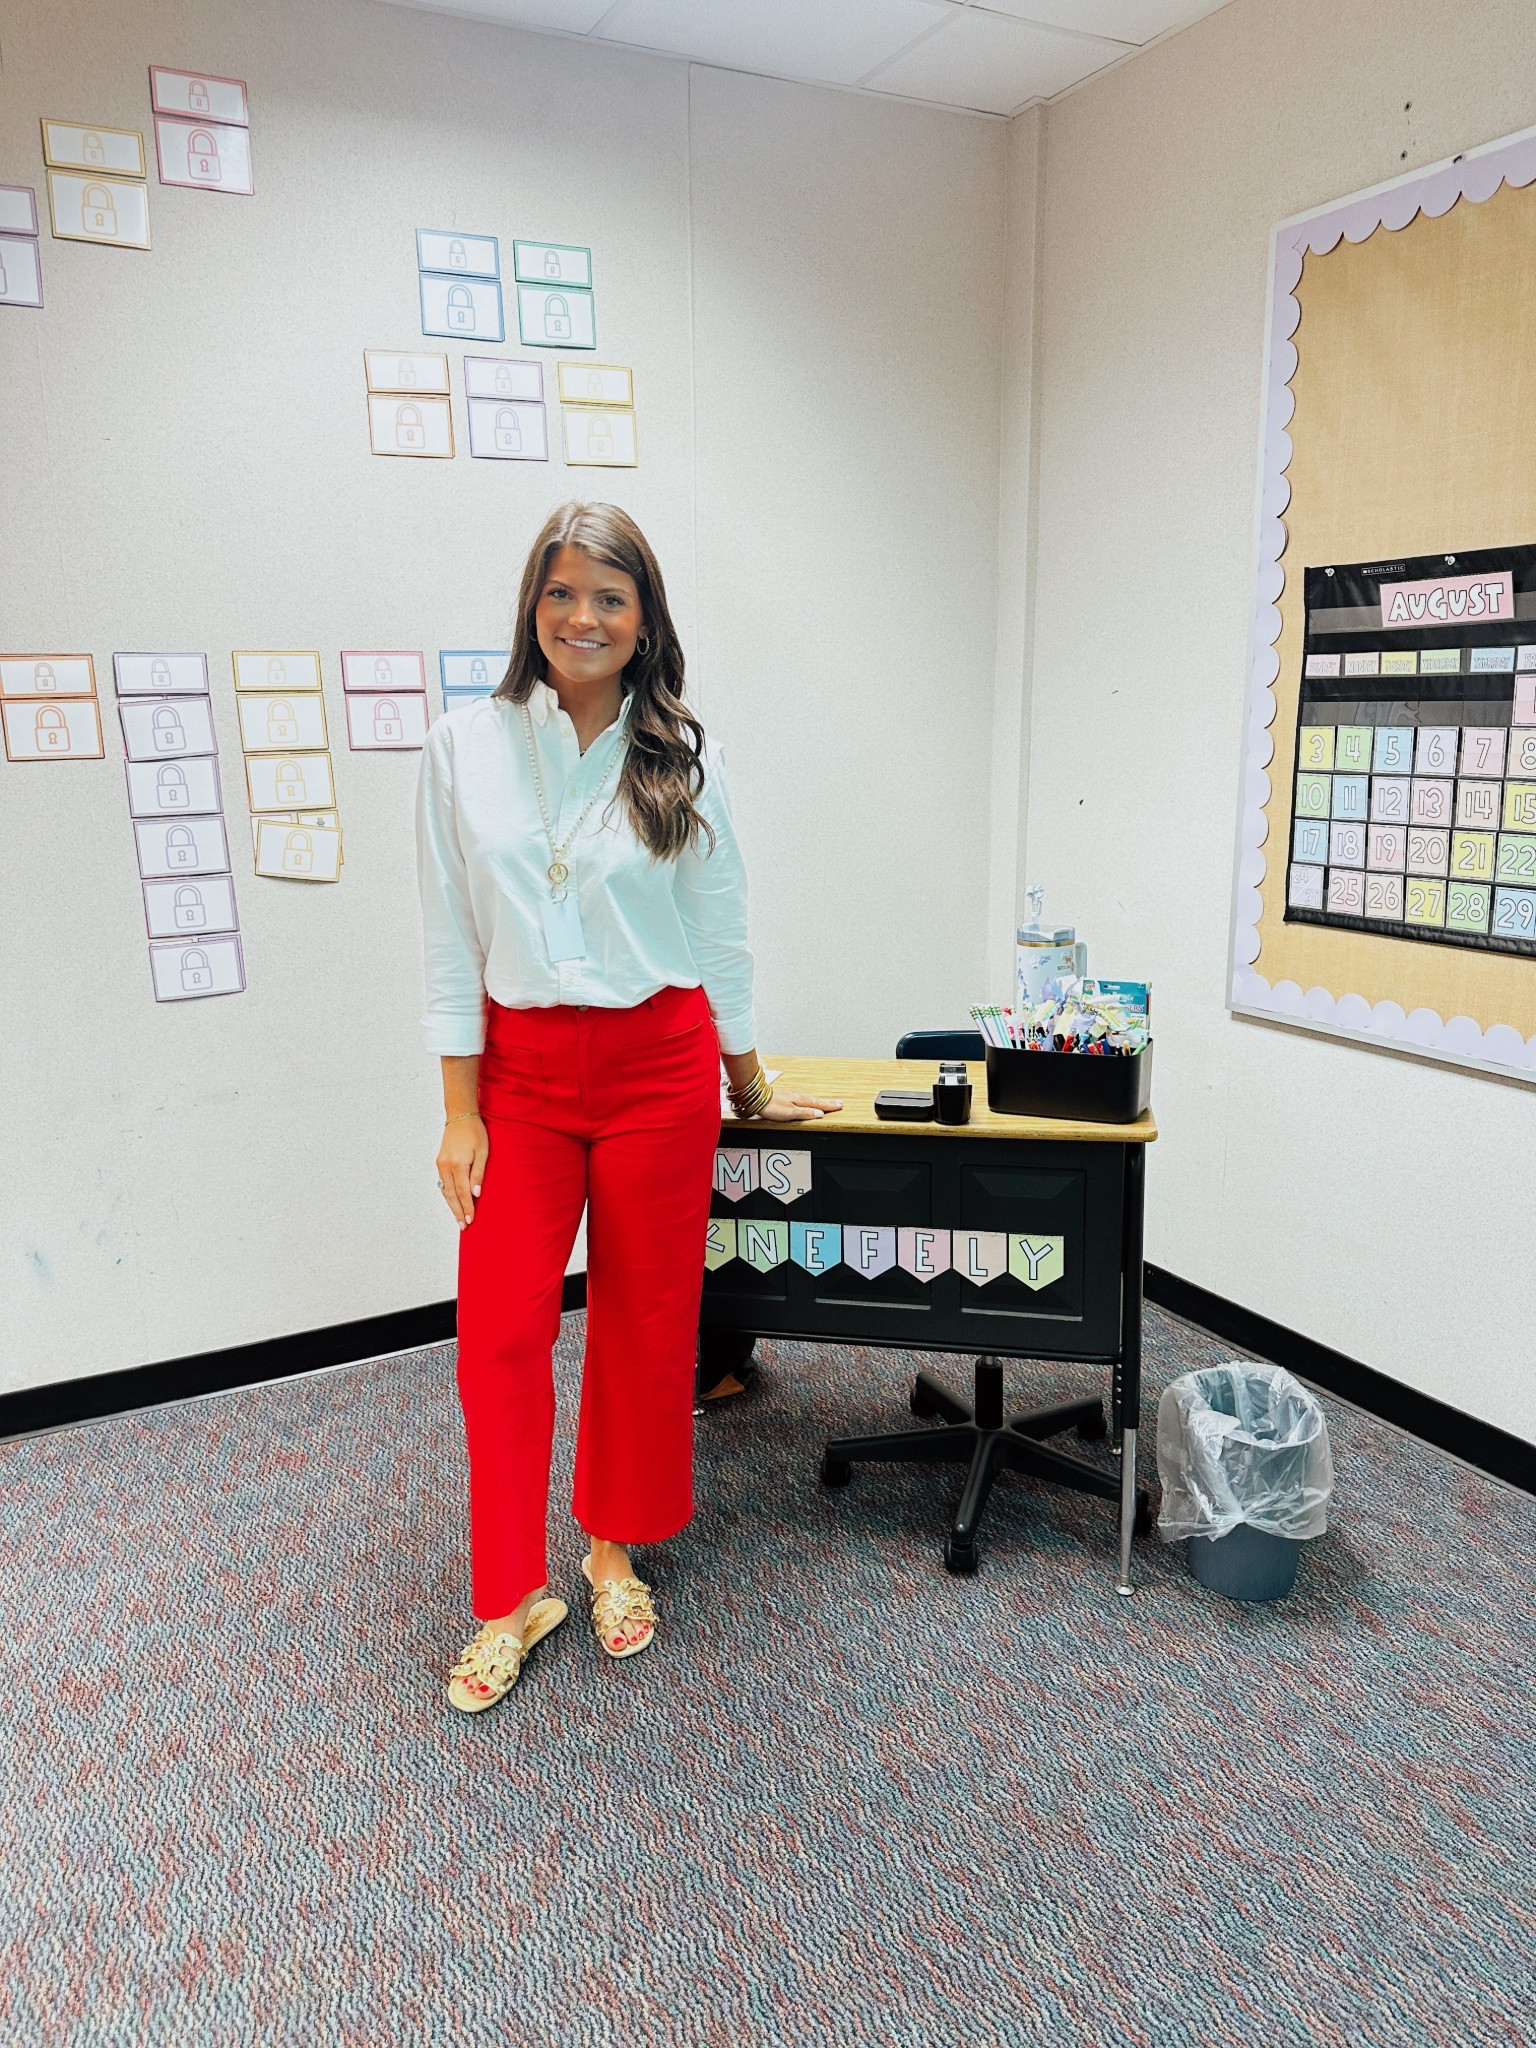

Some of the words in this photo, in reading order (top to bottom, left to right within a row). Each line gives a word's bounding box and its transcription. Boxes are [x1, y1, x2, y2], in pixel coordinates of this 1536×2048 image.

[1367, 565, 1404, 574] SCHOLASTIC
[1388, 582, 1505, 622] AUGUST
[1310, 734, 1326, 763] 3
[1345, 736, 1361, 762] 4
[1384, 736, 1401, 765] 5
[1427, 735, 1445, 767] 6
[1476, 738, 1492, 768] 7
[1520, 737, 1536, 770] 8
[1301, 782, 1325, 810] 10
[1344, 785, 1357, 810] 11
[1378, 786, 1403, 816] 12
[1418, 787, 1444, 818] 13
[1465, 790, 1493, 819] 14
[1514, 793, 1536, 824] 15
[1302, 828, 1321, 855] 17
[1337, 830, 1359, 859] 18
[1376, 833, 1397, 862] 19
[1410, 836, 1445, 864] 20
[1458, 840, 1486, 870] 21
[1499, 843, 1536, 876] 22
[1293, 868, 1308, 884] 24
[1304, 889, 1320, 906] 31
[1331, 877, 1359, 906] 25
[1368, 881, 1399, 910] 26
[1409, 888, 1442, 917] 27
[1450, 892, 1485, 922] 28
[1497, 897, 1534, 929] 29
[716, 1153, 805, 1195] MS.
